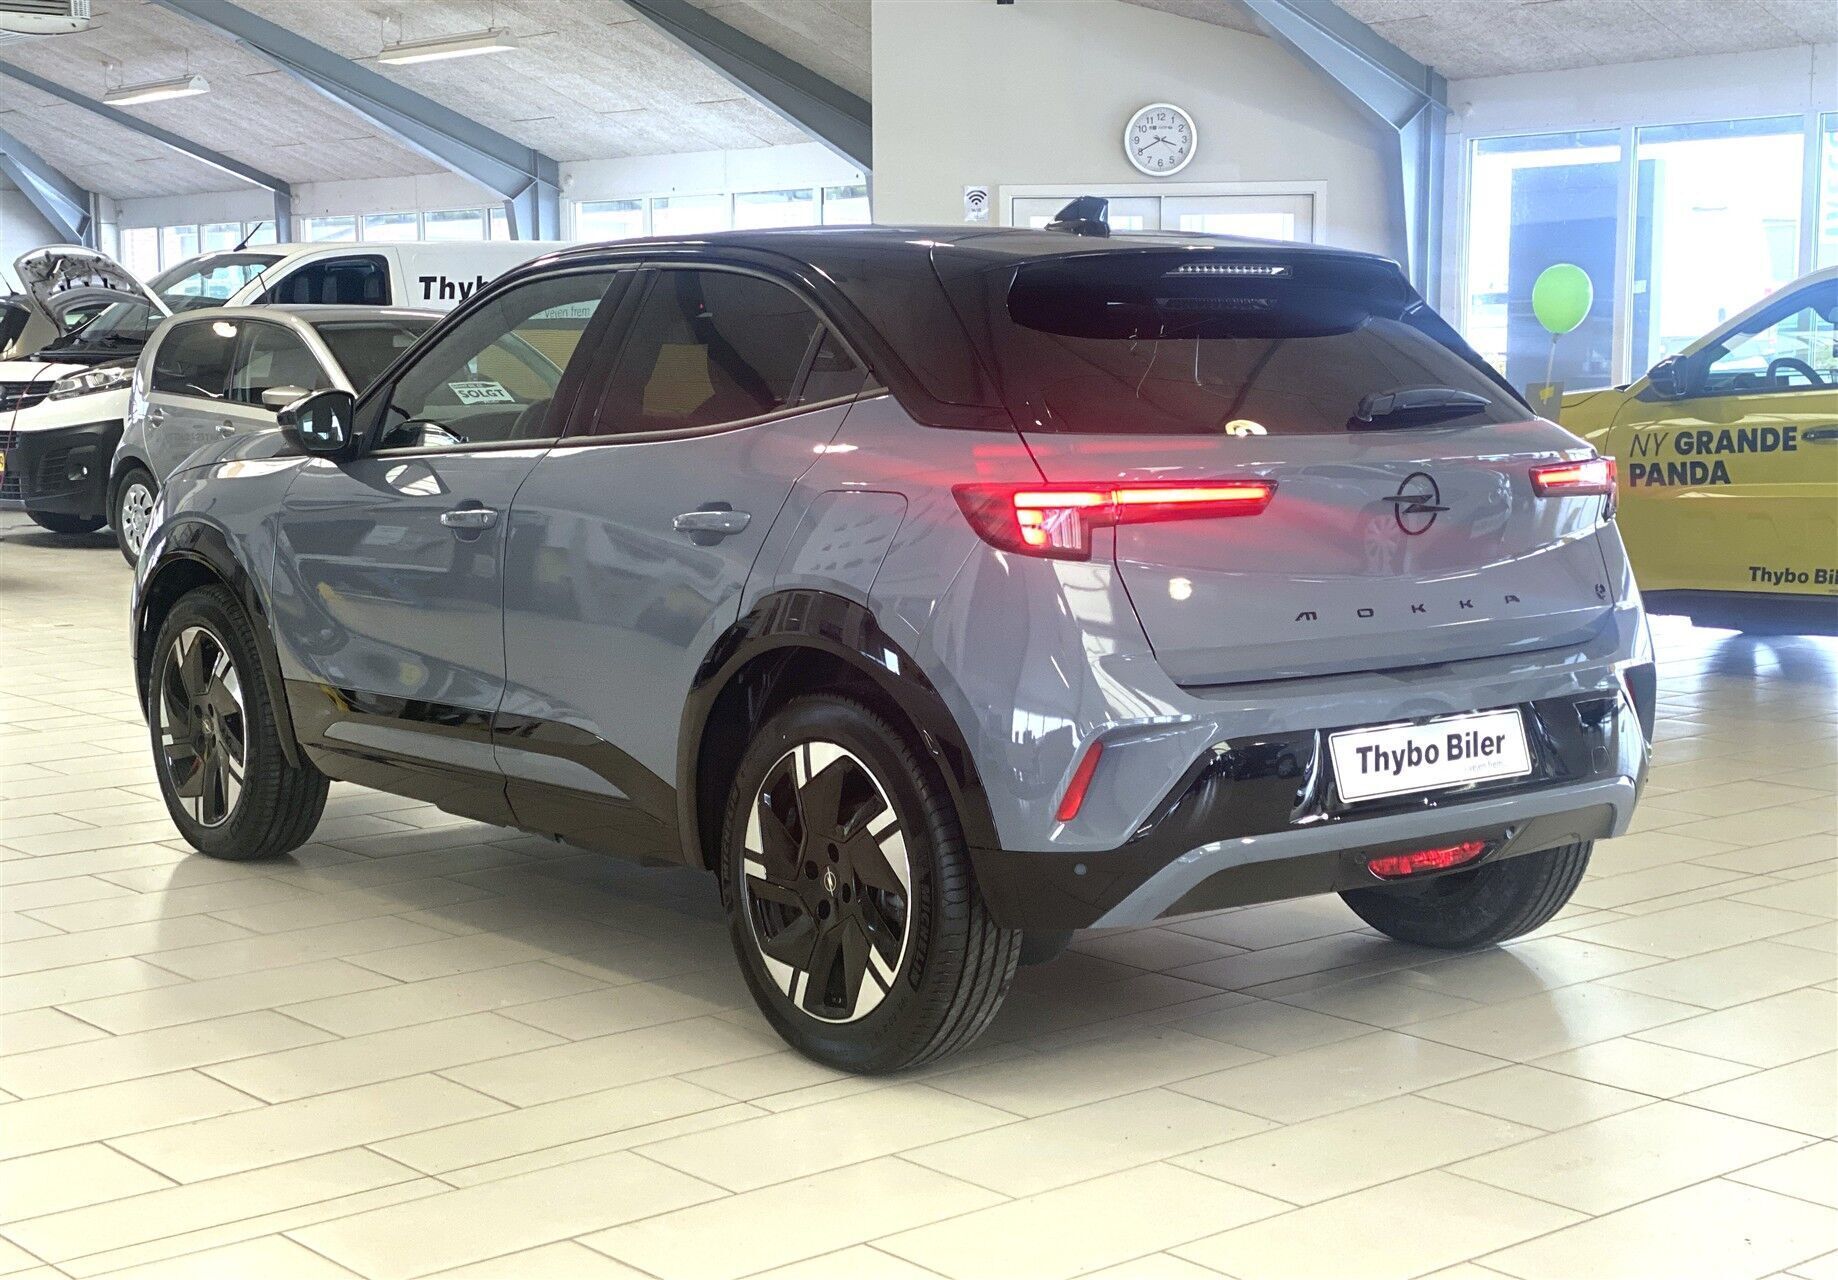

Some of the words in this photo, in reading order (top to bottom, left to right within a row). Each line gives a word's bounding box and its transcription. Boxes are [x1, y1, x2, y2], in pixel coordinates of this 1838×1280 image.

[1146, 116, 1154, 125] 11
[1157, 112, 1166, 121] 12
[1138, 124, 1148, 133] 10
[1178, 124, 1184, 133] 2
[1134, 136, 1140, 145] 9
[1181, 135, 1188, 144] 3
[1146, 156, 1153, 164] 7
[1157, 158, 1164, 167] 6
[1168, 155, 1175, 164] 5
[459, 389, 505, 398] SOLGT
[1629, 432, 1669, 458] NY
[1674, 426, 1798, 455] GRANDE
[1629, 460, 1732, 487] PANDA
[1749, 566, 1809, 586] Thybo
[1295, 594, 1521, 622] MOKKA
[1356, 739, 1440, 776] Thybo
[1446, 730, 1506, 762] Biler
